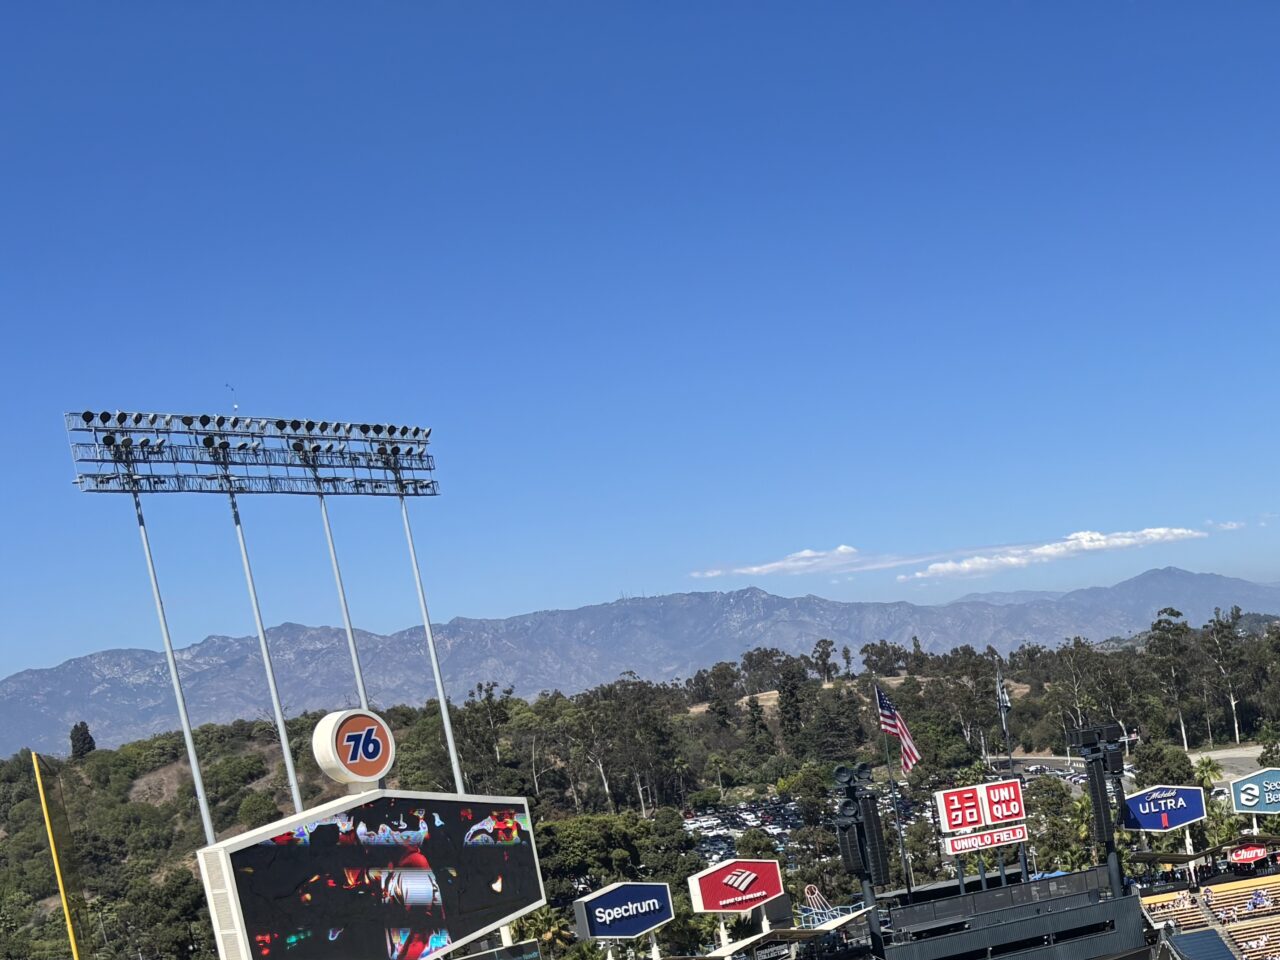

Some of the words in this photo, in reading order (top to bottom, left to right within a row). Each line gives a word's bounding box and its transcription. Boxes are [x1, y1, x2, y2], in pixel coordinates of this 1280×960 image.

[344, 726, 382, 763] 76
[949, 793, 976, 810] ユニ
[990, 786, 1015, 803] UNI
[993, 801, 1020, 818] QLO
[1139, 797, 1187, 814] ULTRA
[951, 810, 978, 826] クロ
[954, 834, 991, 850] UNIQLO
[994, 828, 1023, 842] FIELD
[1232, 847, 1265, 861] Churu
[595, 899, 659, 924] Spectrum
